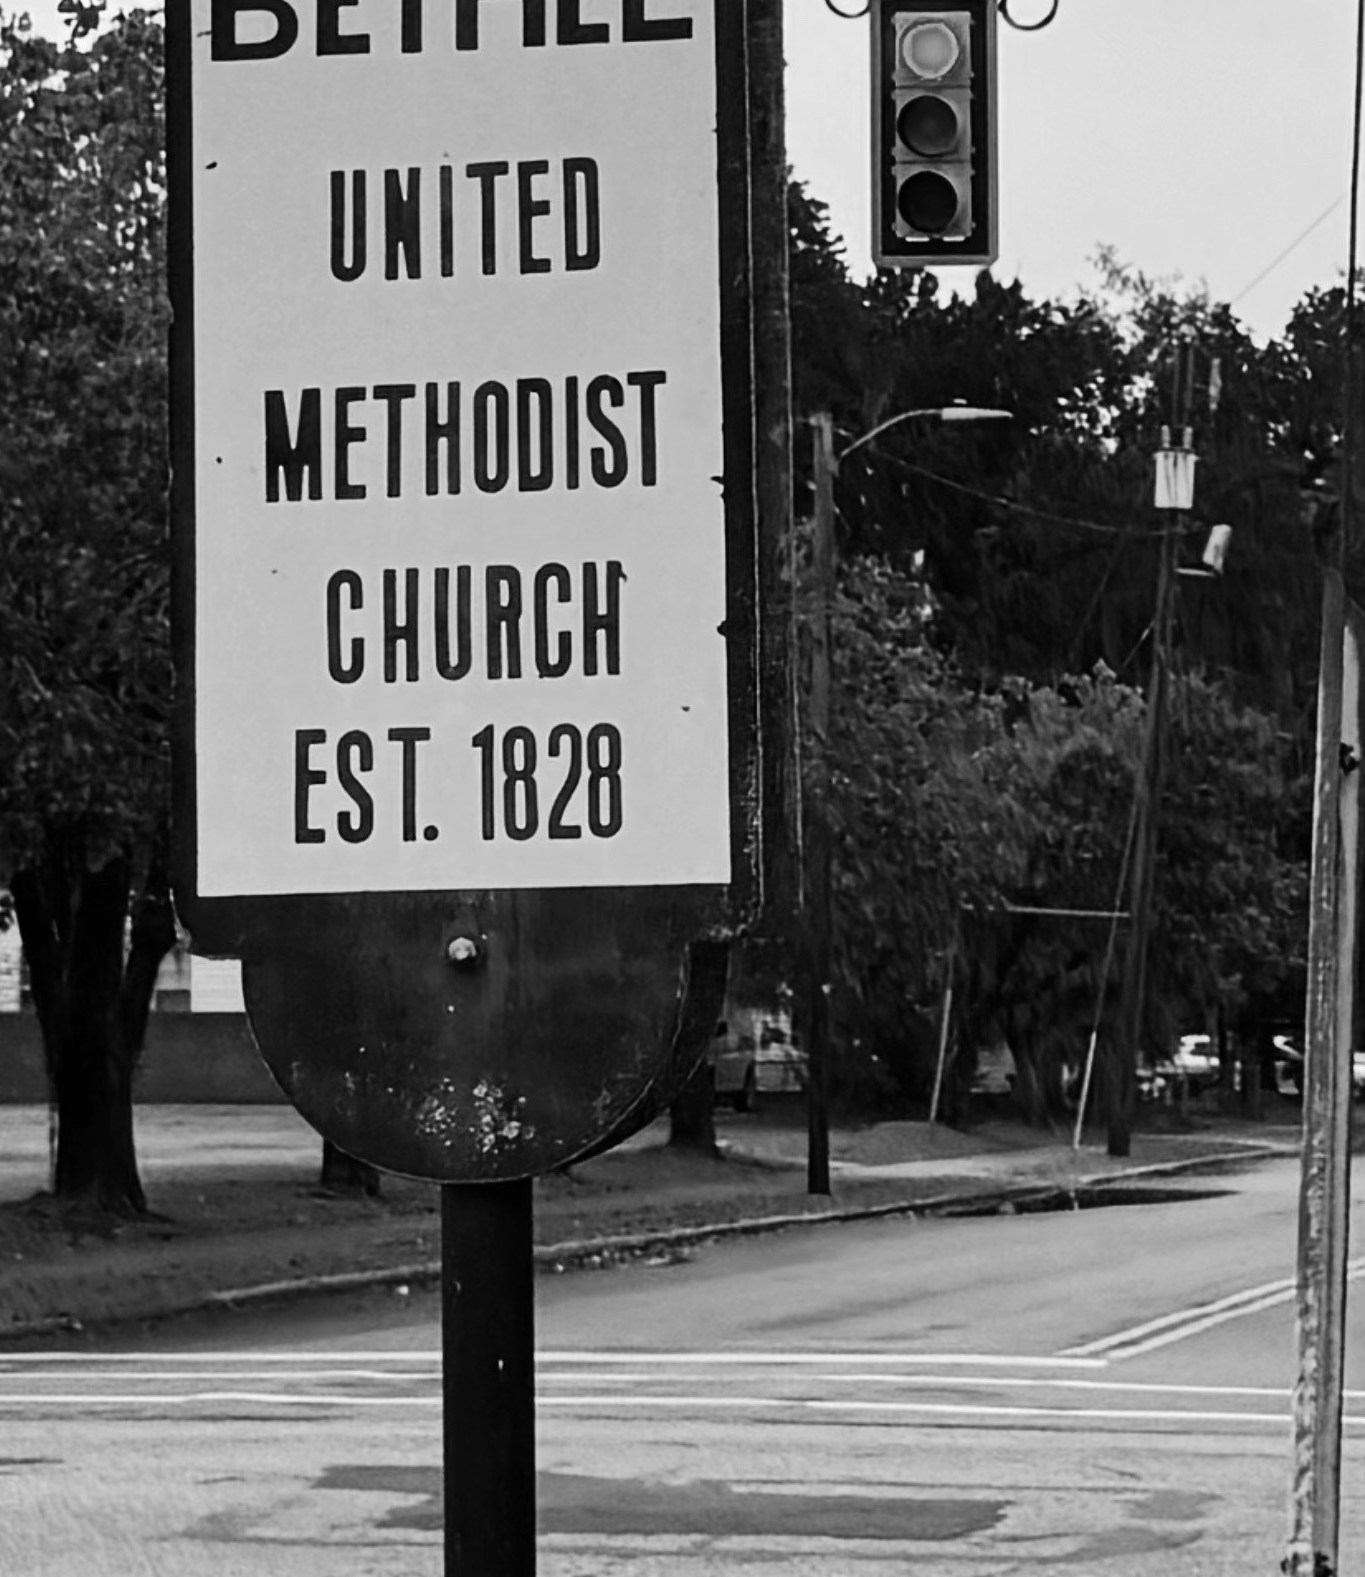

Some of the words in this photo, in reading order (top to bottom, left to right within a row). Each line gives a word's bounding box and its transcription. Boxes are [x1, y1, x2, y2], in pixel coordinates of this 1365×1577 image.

[330, 156, 601, 283] UNITED
[264, 370, 667, 504] METHODIST
[326, 560, 626, 684] CHURCH
[294, 727, 440, 845] EST.
[471, 722, 623, 841] 1828
